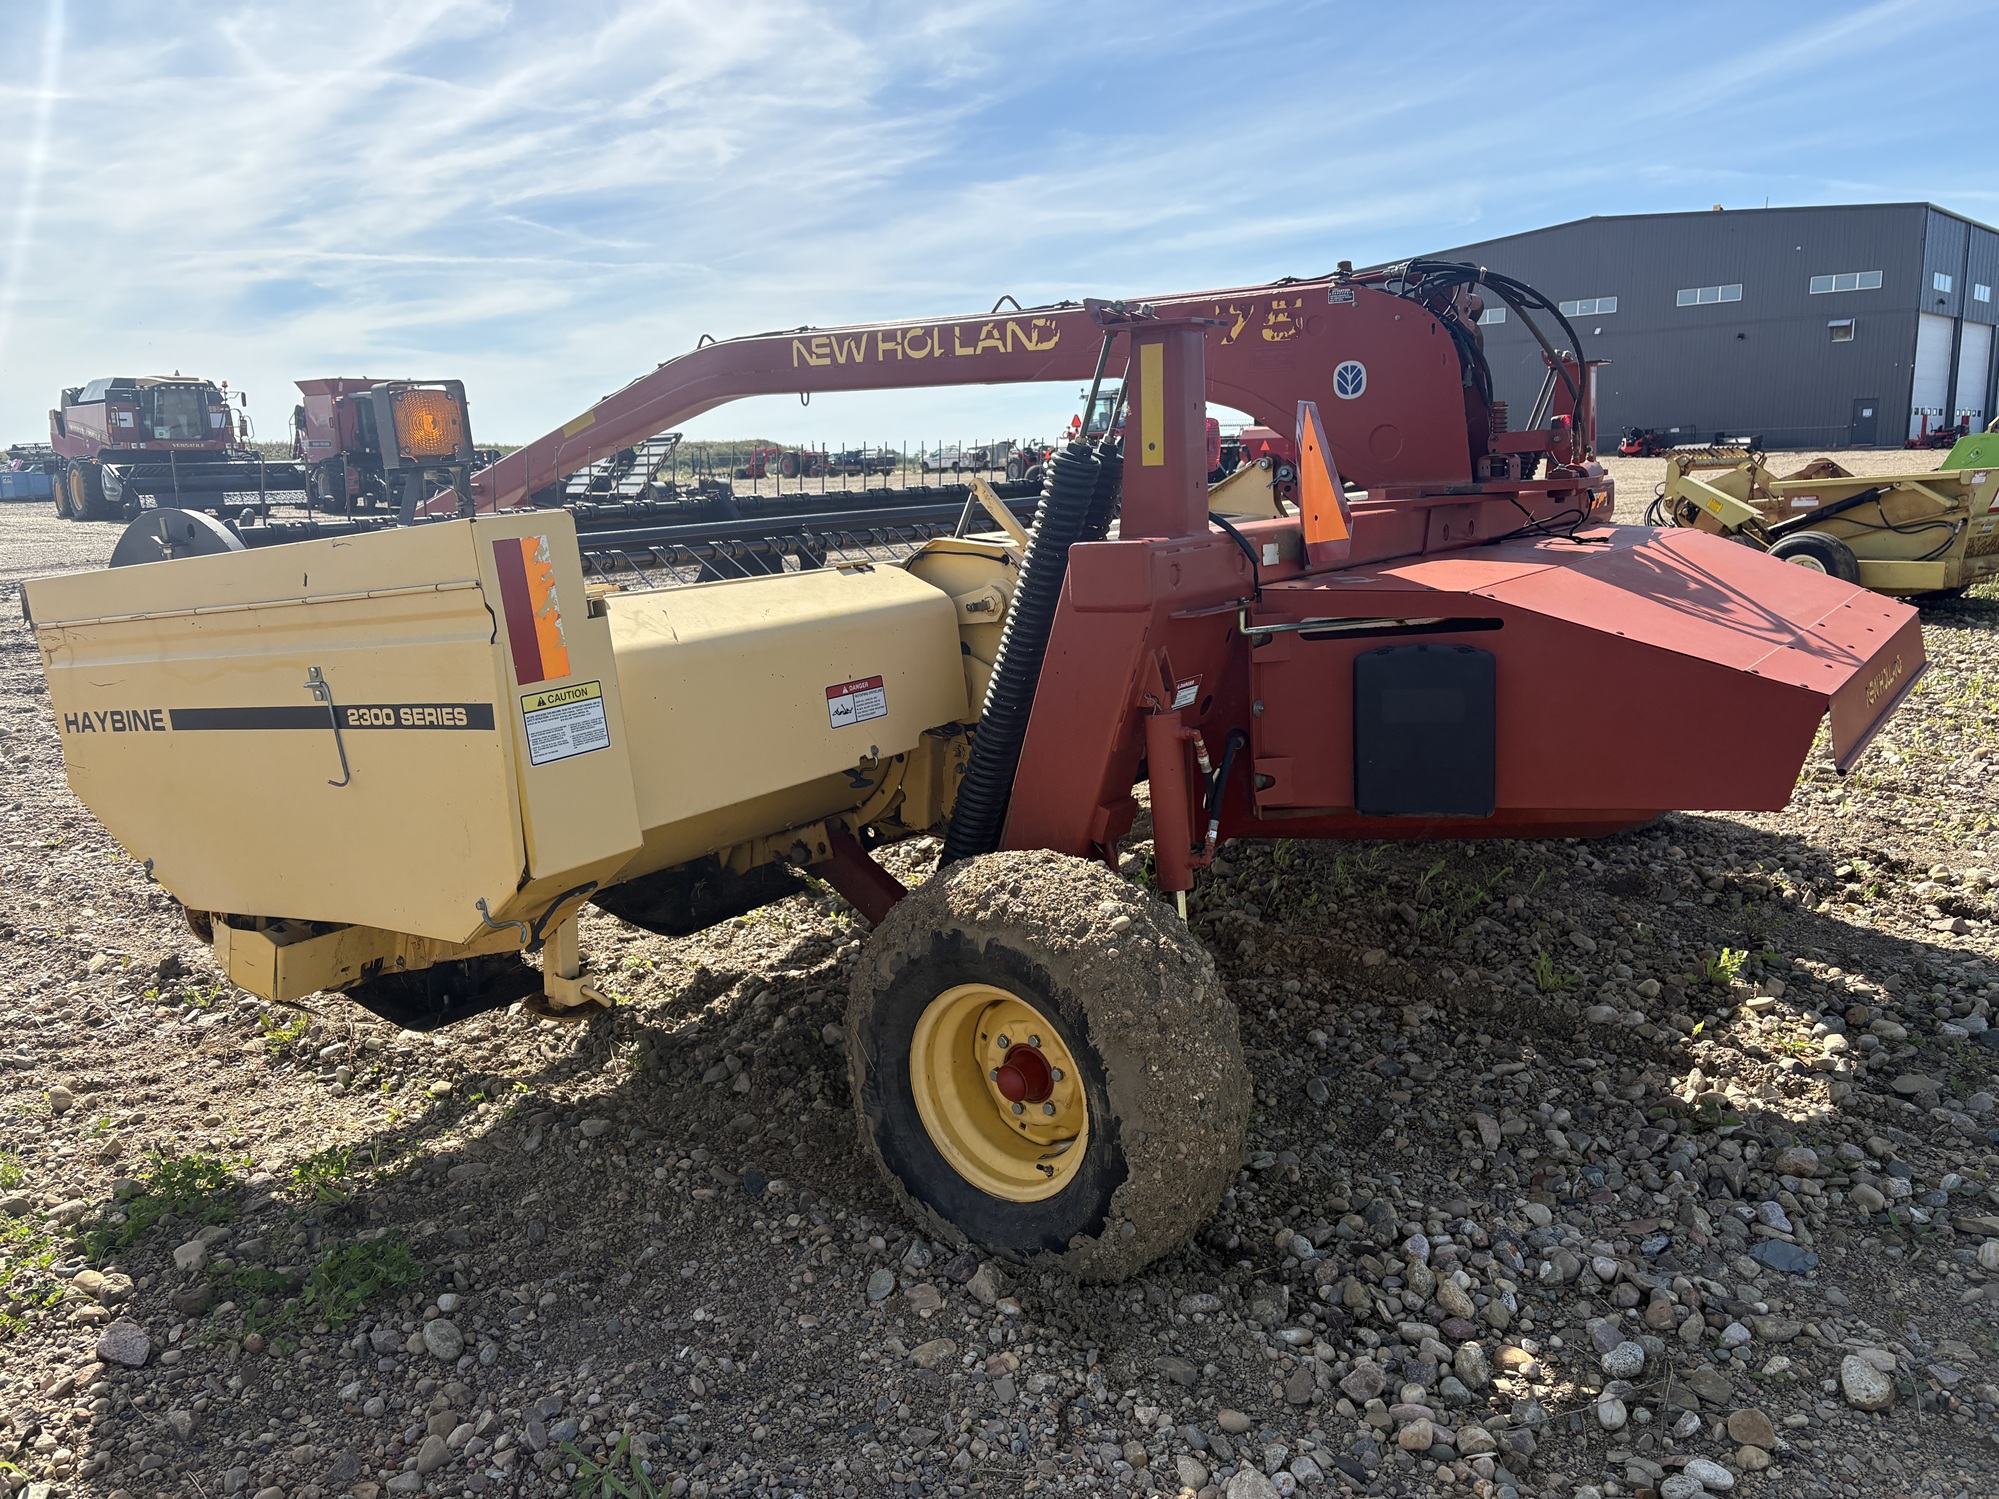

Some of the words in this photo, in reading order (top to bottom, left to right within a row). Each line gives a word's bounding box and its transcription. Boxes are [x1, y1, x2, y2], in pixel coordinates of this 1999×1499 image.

[792, 332, 867, 367] NEW
[877, 318, 1060, 361] HOLLAND
[547, 687, 588, 704] CAUTION
[849, 682, 868, 691] DANGER
[64, 708, 166, 734] HAYBINE
[346, 708, 395, 726] 2300
[399, 707, 468, 726] SERIES
